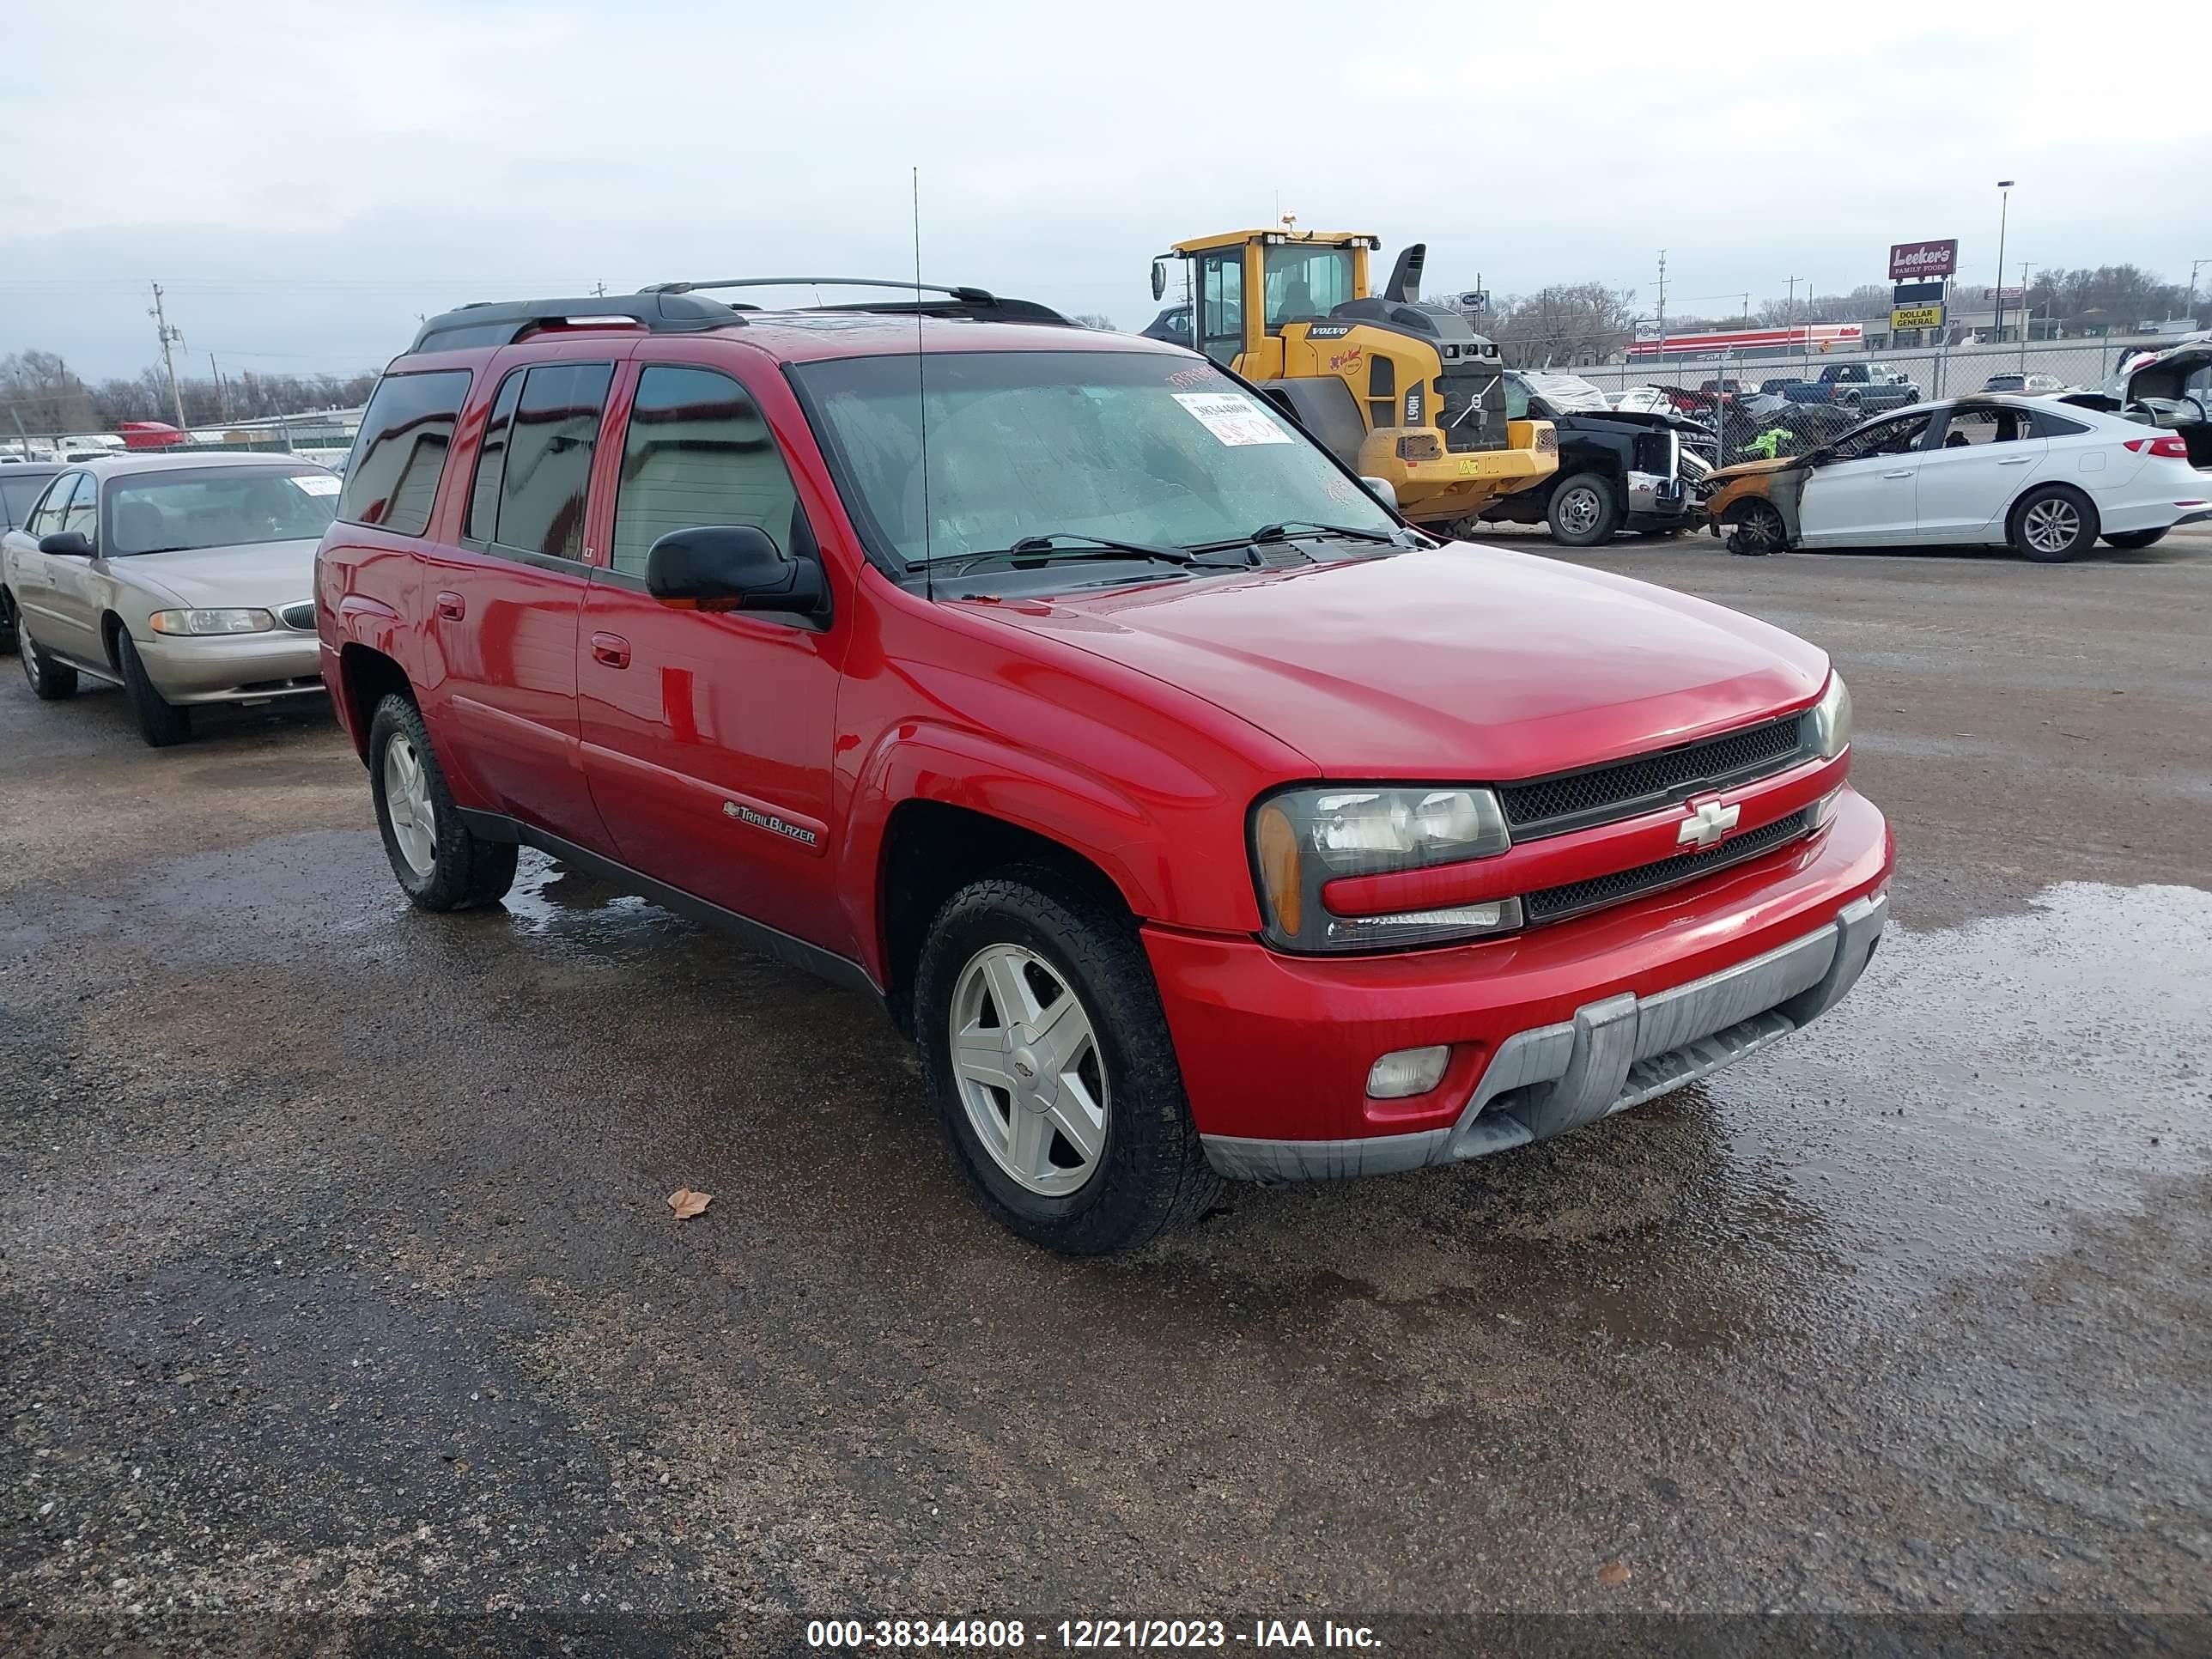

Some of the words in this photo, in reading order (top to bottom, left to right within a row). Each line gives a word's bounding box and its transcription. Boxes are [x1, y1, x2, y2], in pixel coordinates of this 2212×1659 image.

[1893, 246, 1951, 266] Leeker's
[1923, 264, 1947, 272] FOODS
[1900, 310, 1933, 319] DOLLAR
[1897, 318, 1935, 326] GENERAL
[1193, 404, 1253, 417] 38344808
[1408, 395, 1419, 421] L90H
[584, 547, 594, 557] LT
